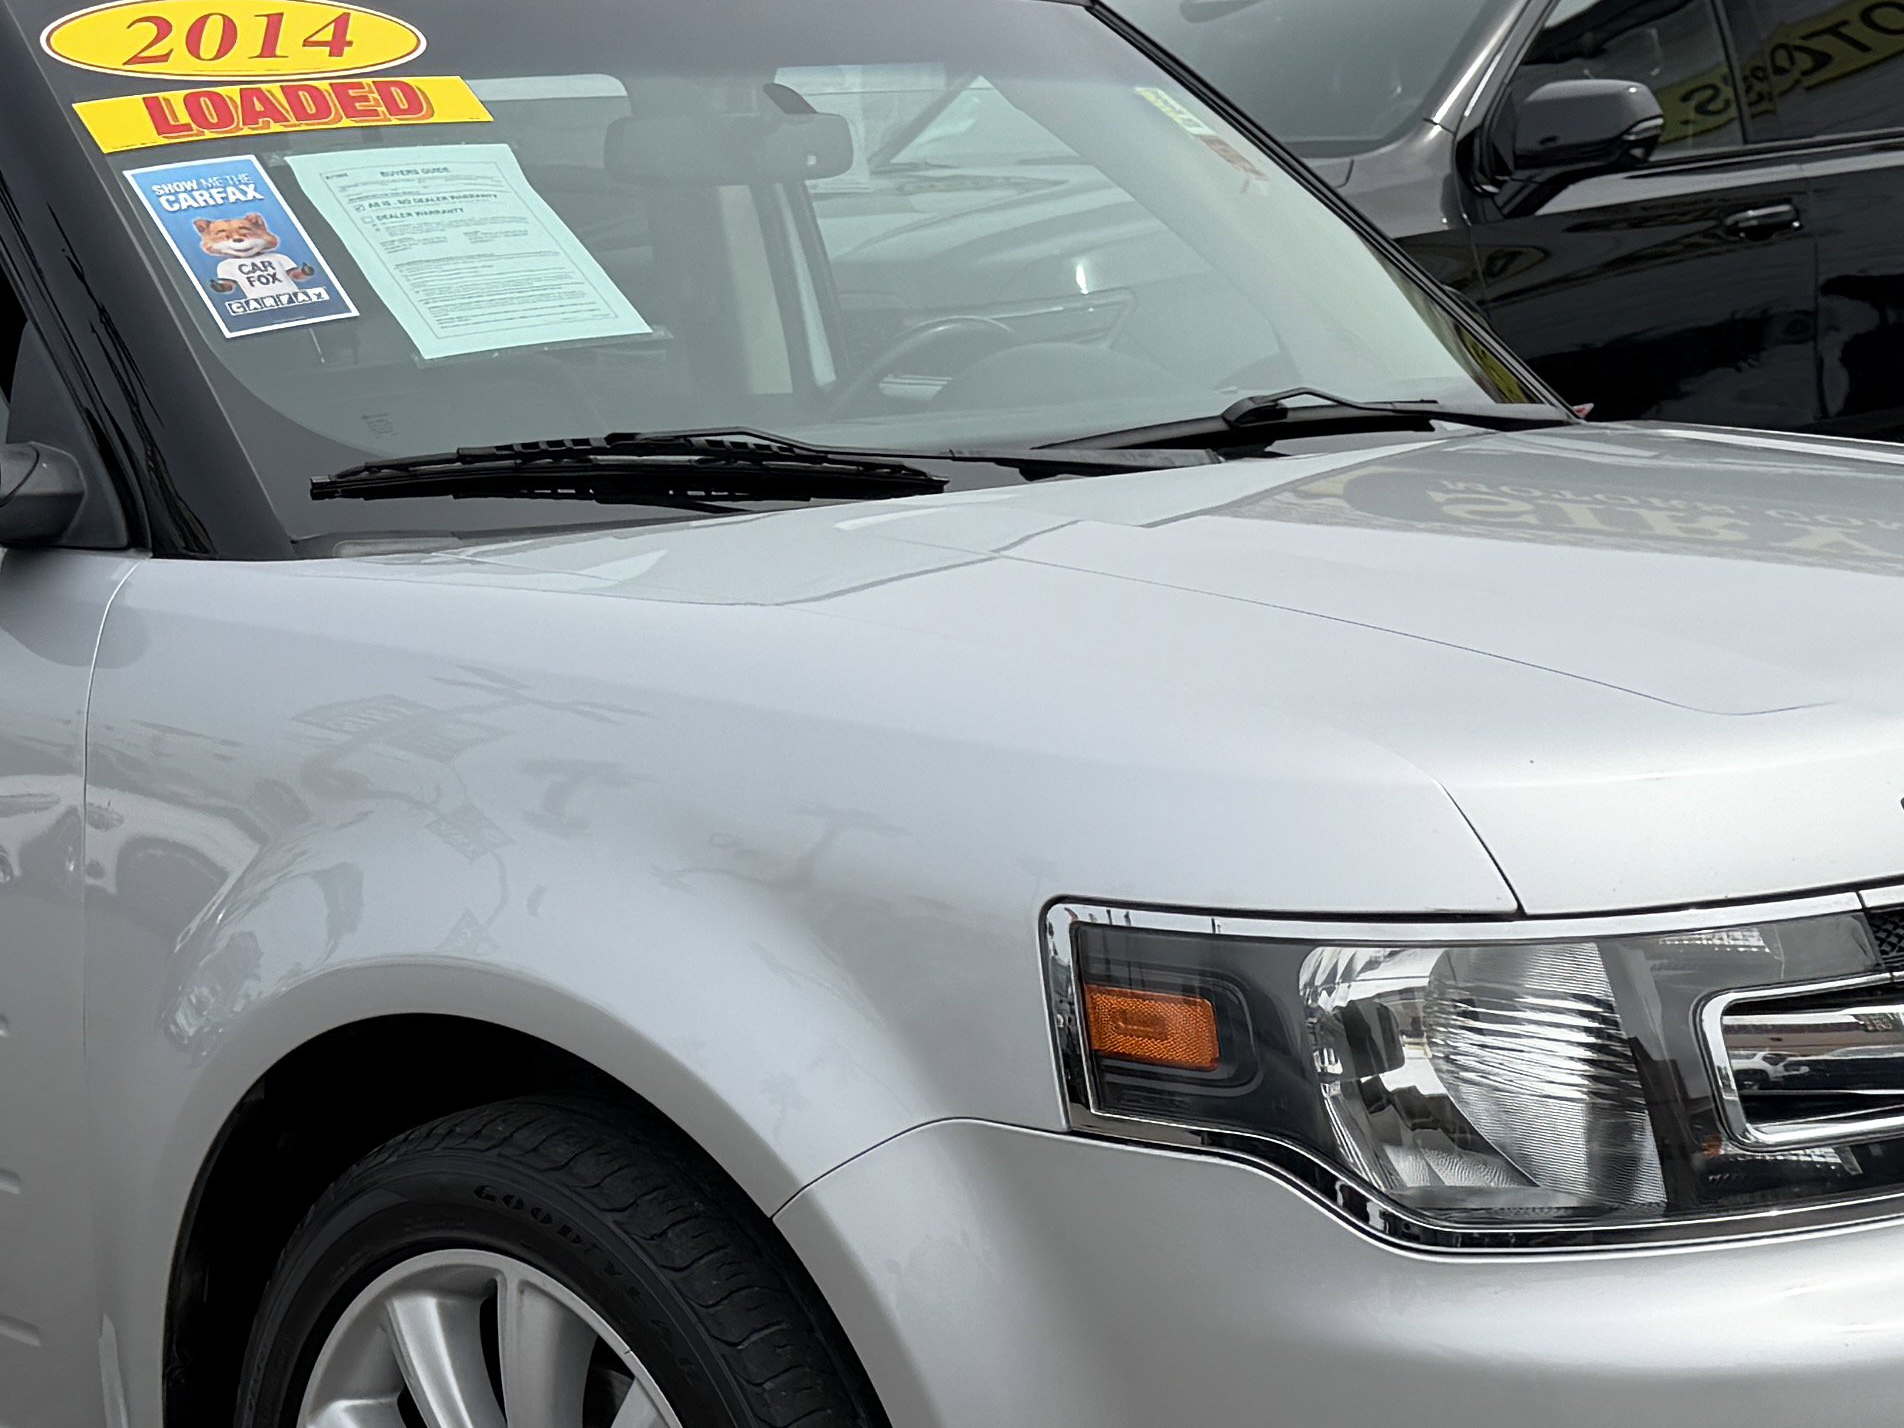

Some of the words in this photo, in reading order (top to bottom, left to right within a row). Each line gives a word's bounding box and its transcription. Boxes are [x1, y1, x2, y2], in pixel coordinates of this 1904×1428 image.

[122, 11, 354, 66] 2014
[143, 80, 434, 139] LOADED
[152, 180, 197, 197] SHOW
[159, 184, 264, 212] CARFAX
[238, 259, 276, 276] CAR
[246, 272, 282, 288] FOX
[227, 287, 326, 315] CARFAX
